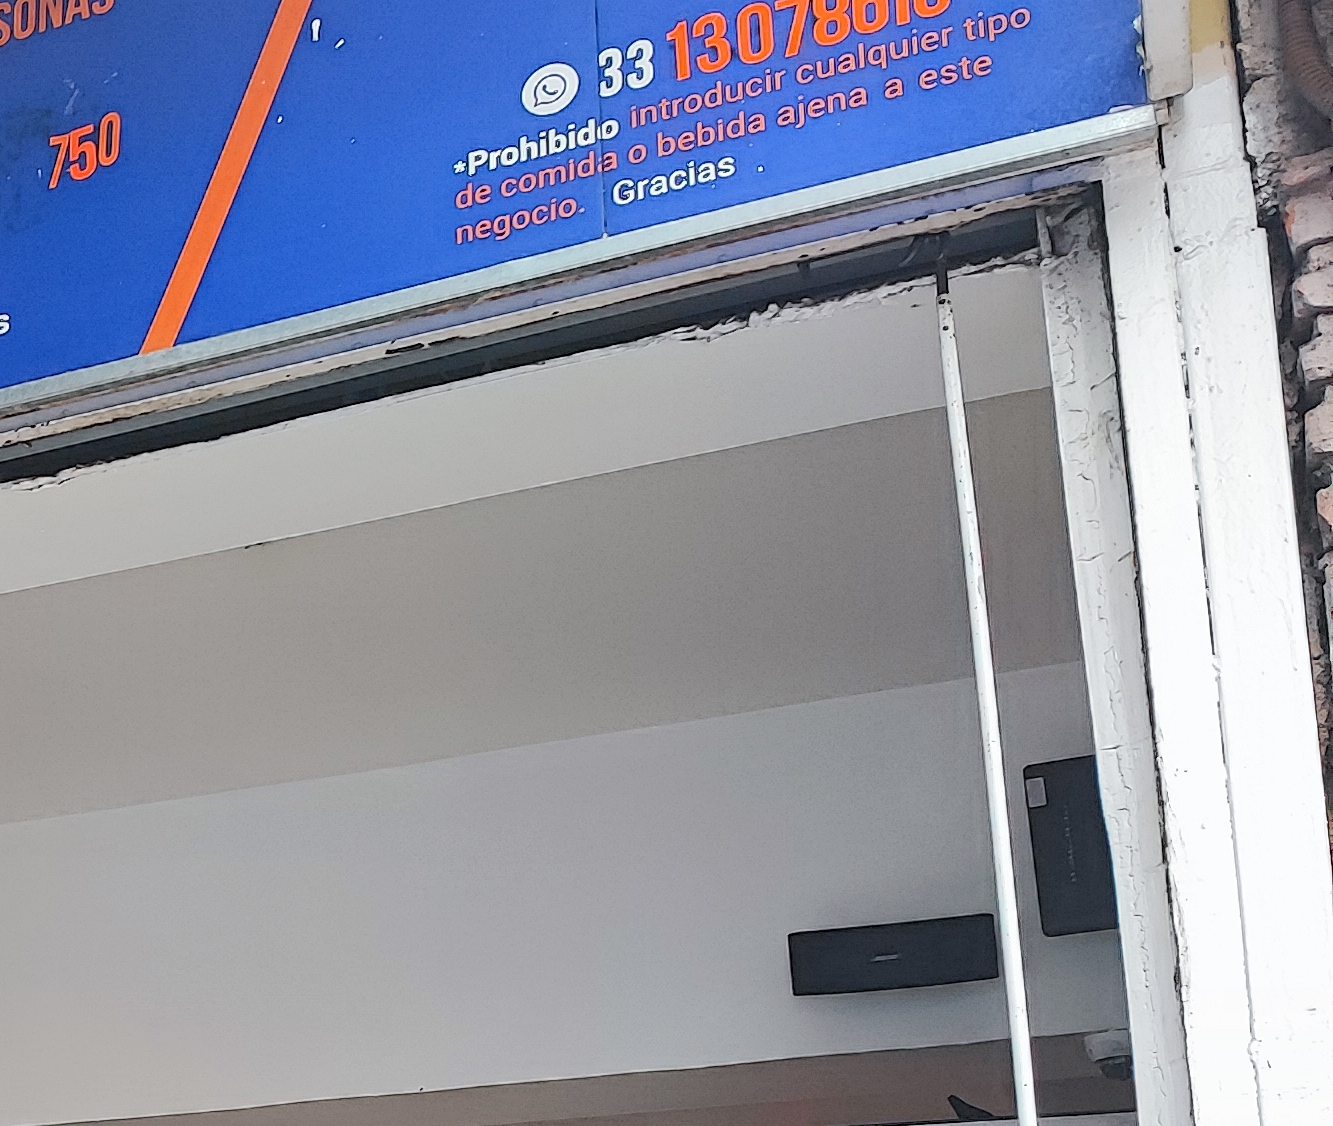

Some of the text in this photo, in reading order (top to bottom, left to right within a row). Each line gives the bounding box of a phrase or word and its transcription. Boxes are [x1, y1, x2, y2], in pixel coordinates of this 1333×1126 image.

[597, 0, 952, 99] 33 130786
[629, 67, 787, 129] introducir
[795, 26, 954, 85] cualquier
[962, 6, 1032, 43] tipo
[48, 110, 123, 190] 750
[454, 54, 994, 210] de comida o bebida ajena a este
[454, 155, 737, 246] negocio. Gracias
